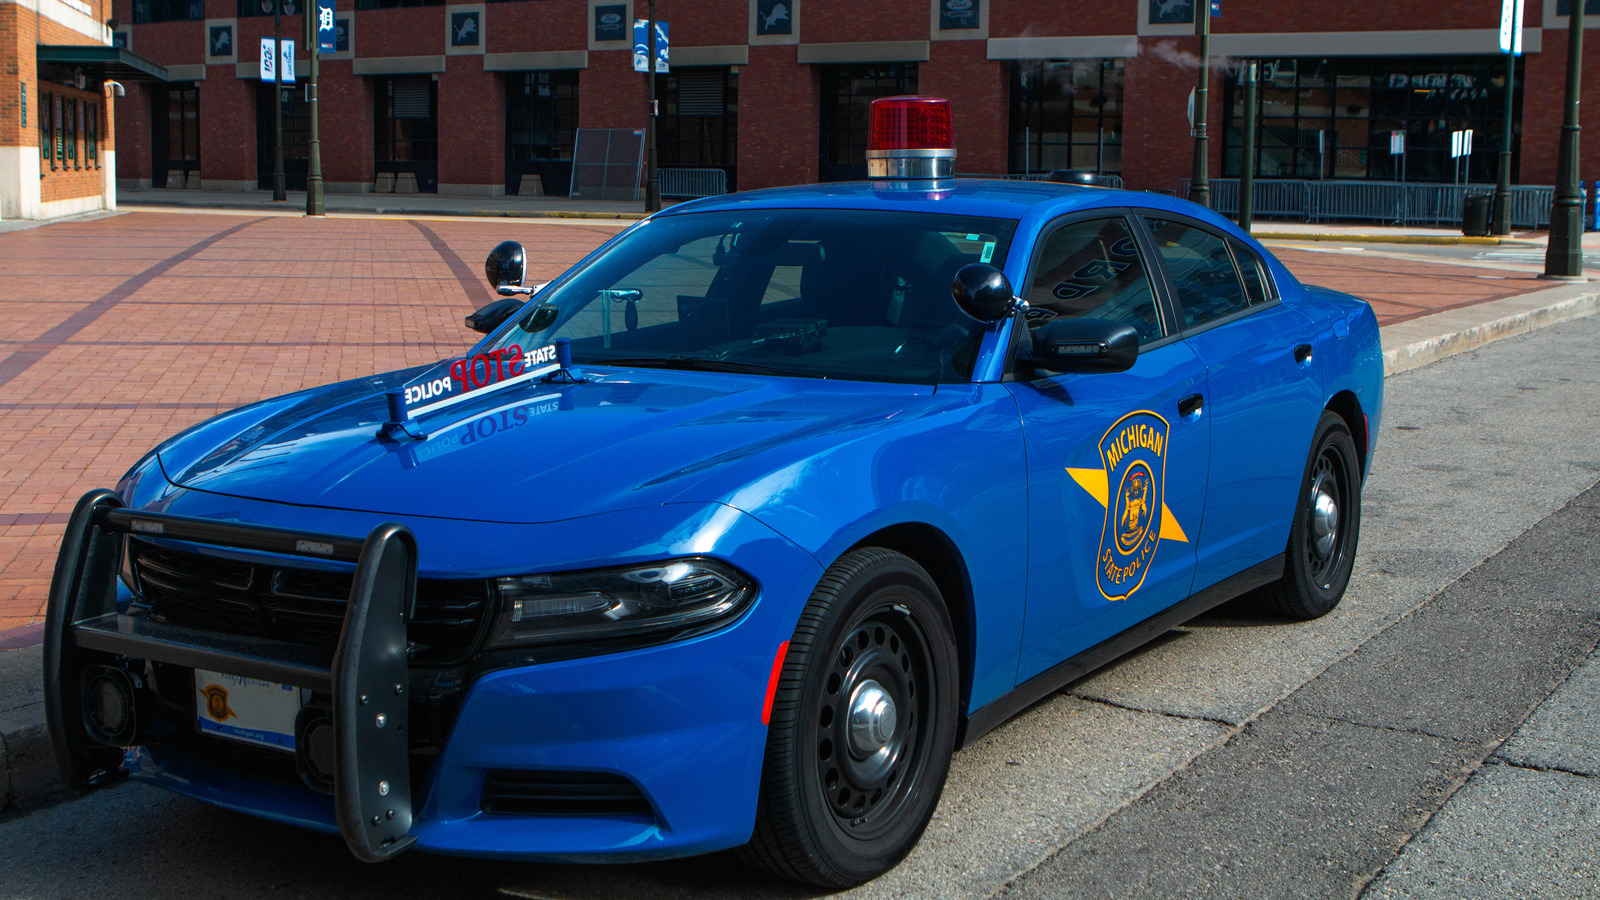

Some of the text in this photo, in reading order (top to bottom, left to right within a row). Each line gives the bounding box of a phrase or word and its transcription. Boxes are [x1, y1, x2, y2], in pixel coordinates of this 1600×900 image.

[460, 406, 528, 446] STOP
[529, 402, 560, 416] STATE
[1106, 424, 1164, 472] MICHIGAN
[1102, 529, 1156, 584] STATE POLICE
